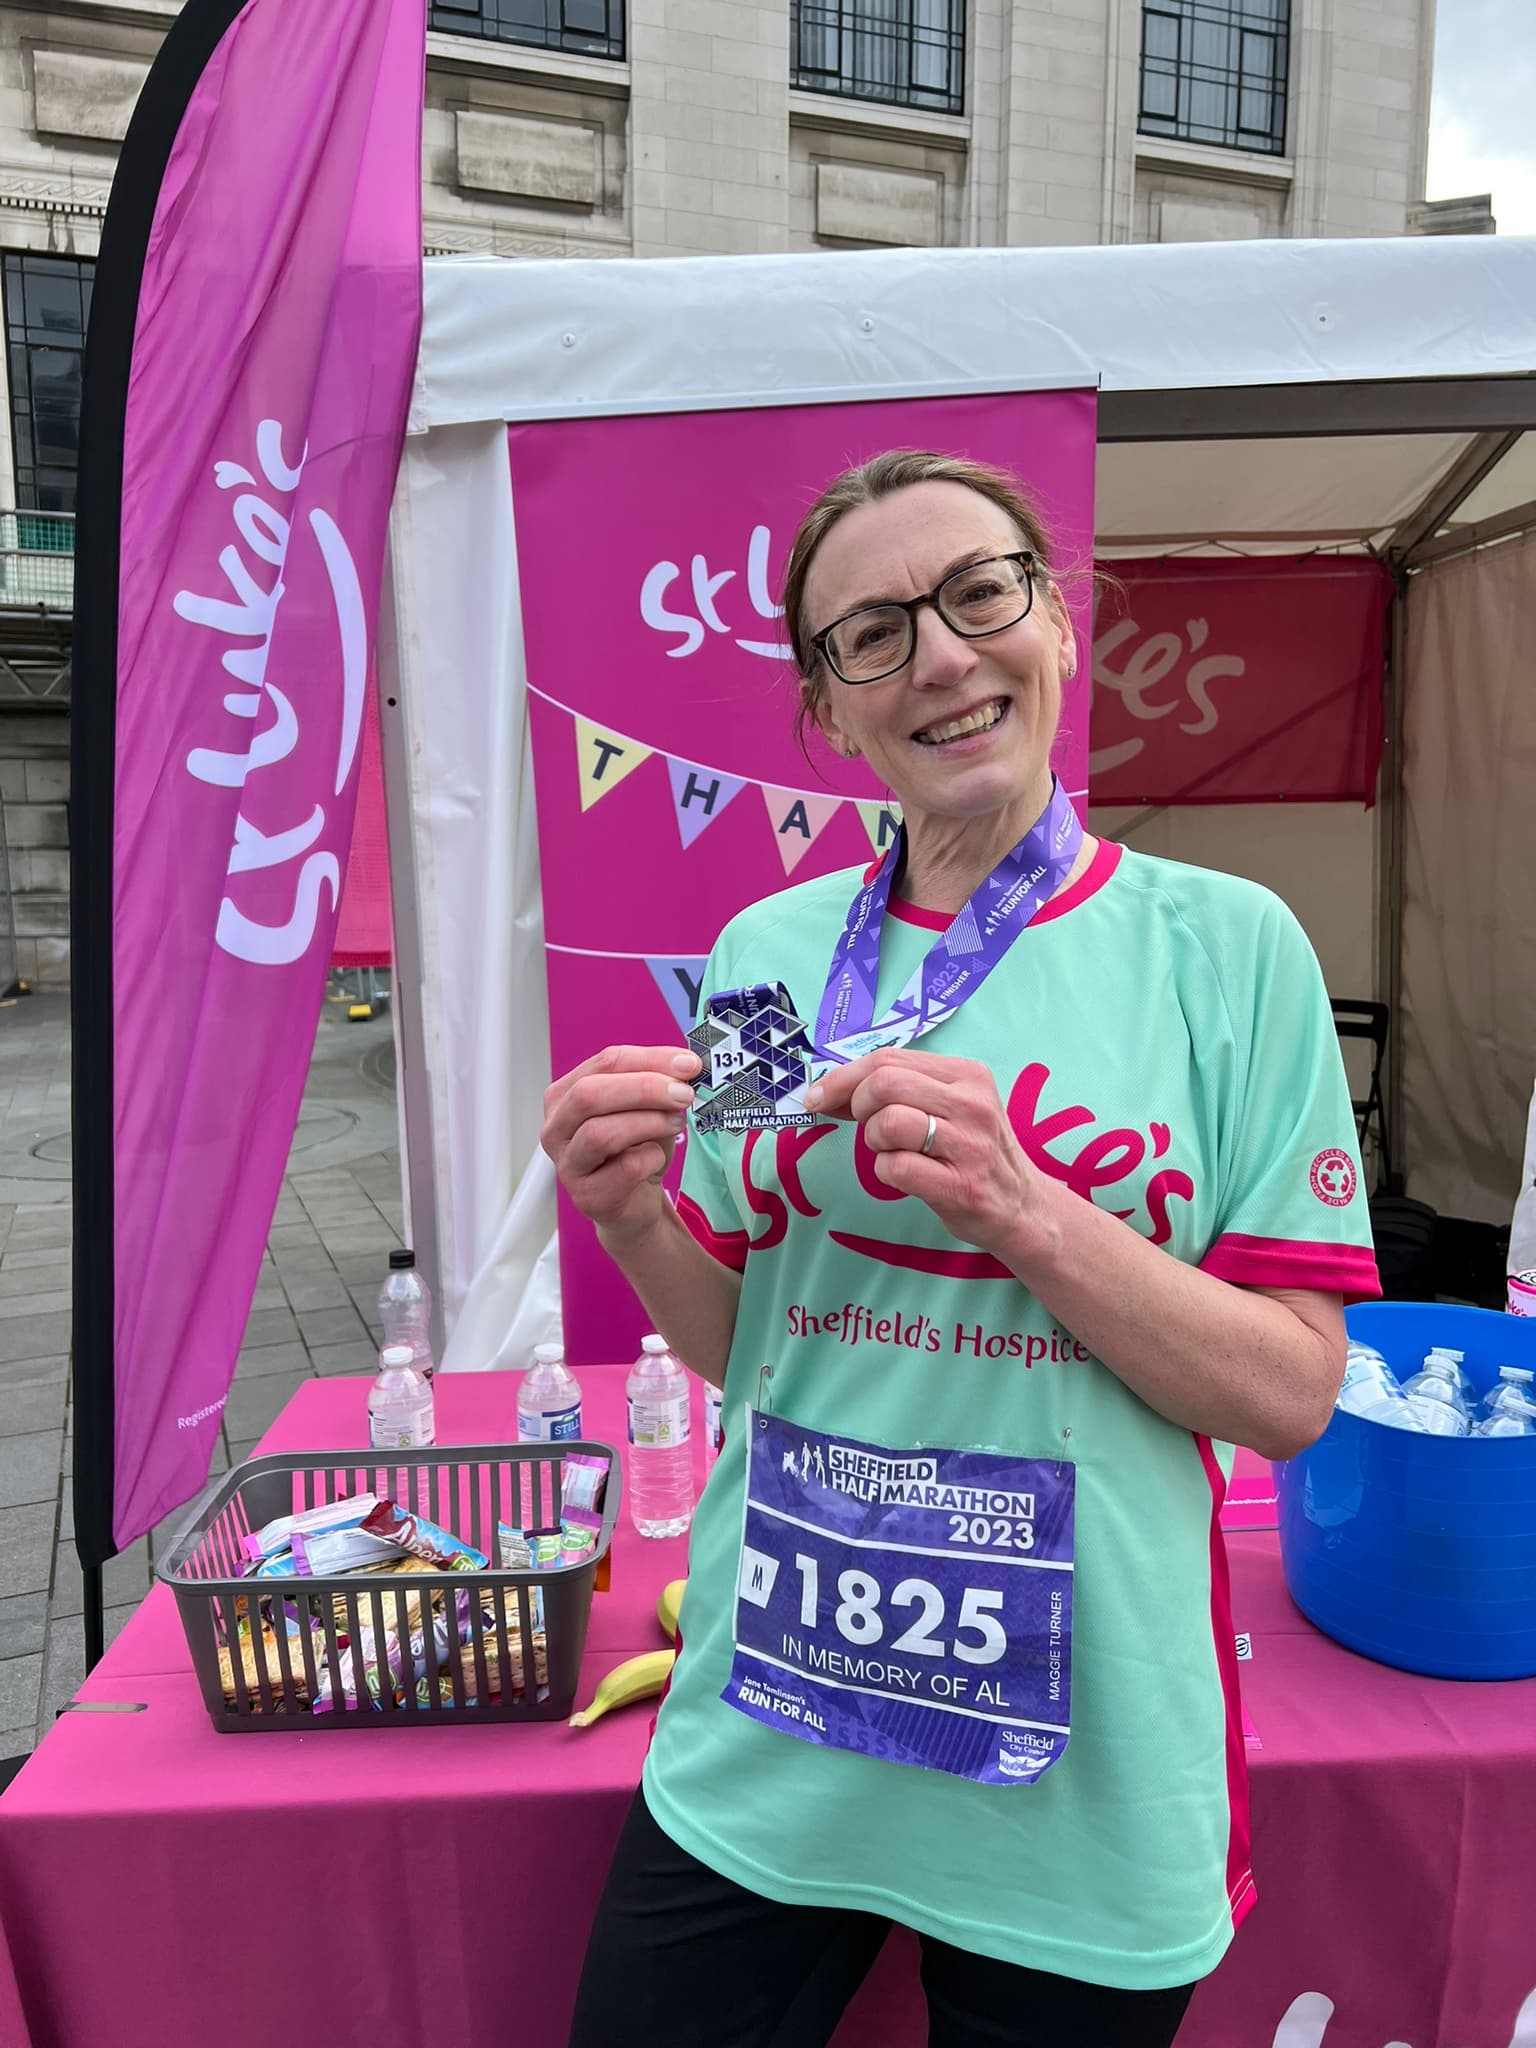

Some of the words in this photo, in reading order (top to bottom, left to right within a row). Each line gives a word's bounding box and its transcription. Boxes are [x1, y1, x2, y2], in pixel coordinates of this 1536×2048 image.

[1001, 894, 1021, 916] RUN
[1015, 879, 1033, 898] FOR
[1029, 864, 1048, 884] ALL
[926, 961, 960, 998] 2023
[939, 969, 971, 1001] FINISHER
[722, 1107, 771, 1118] SHEFFIELD
[723, 1118, 750, 1129] HALF
[752, 1115, 813, 1127] MARATHON
[787, 1304, 941, 1352] Sheffield's
[954, 1323, 1090, 1368] Hospice
[831, 1448, 934, 1482] SHEFFIELD
[831, 1472, 880, 1503] HALF
[884, 1483, 1033, 1517] MARATHON
[948, 1515, 1035, 1550] 2023
[751, 1564, 763, 1592] M
[795, 1552, 1008, 1666] 1825
[1049, 1591, 1063, 1649] TURNER
[743, 1674, 760, 1689] Jane
[762, 1679, 806, 1706] Tomlinson's
[782, 1633, 802, 1661] IN
[808, 1644, 922, 1690] MEMORY
[930, 1673, 968, 1701] OF
[975, 1682, 1011, 1707] AL
[1048, 1651, 1062, 1701] MAGGIE
[737, 1686, 771, 1711] RUN
[771, 1698, 800, 1721] FOR
[802, 1709, 827, 1732] ALL
[1002, 1730, 1054, 1751] Sheffield
